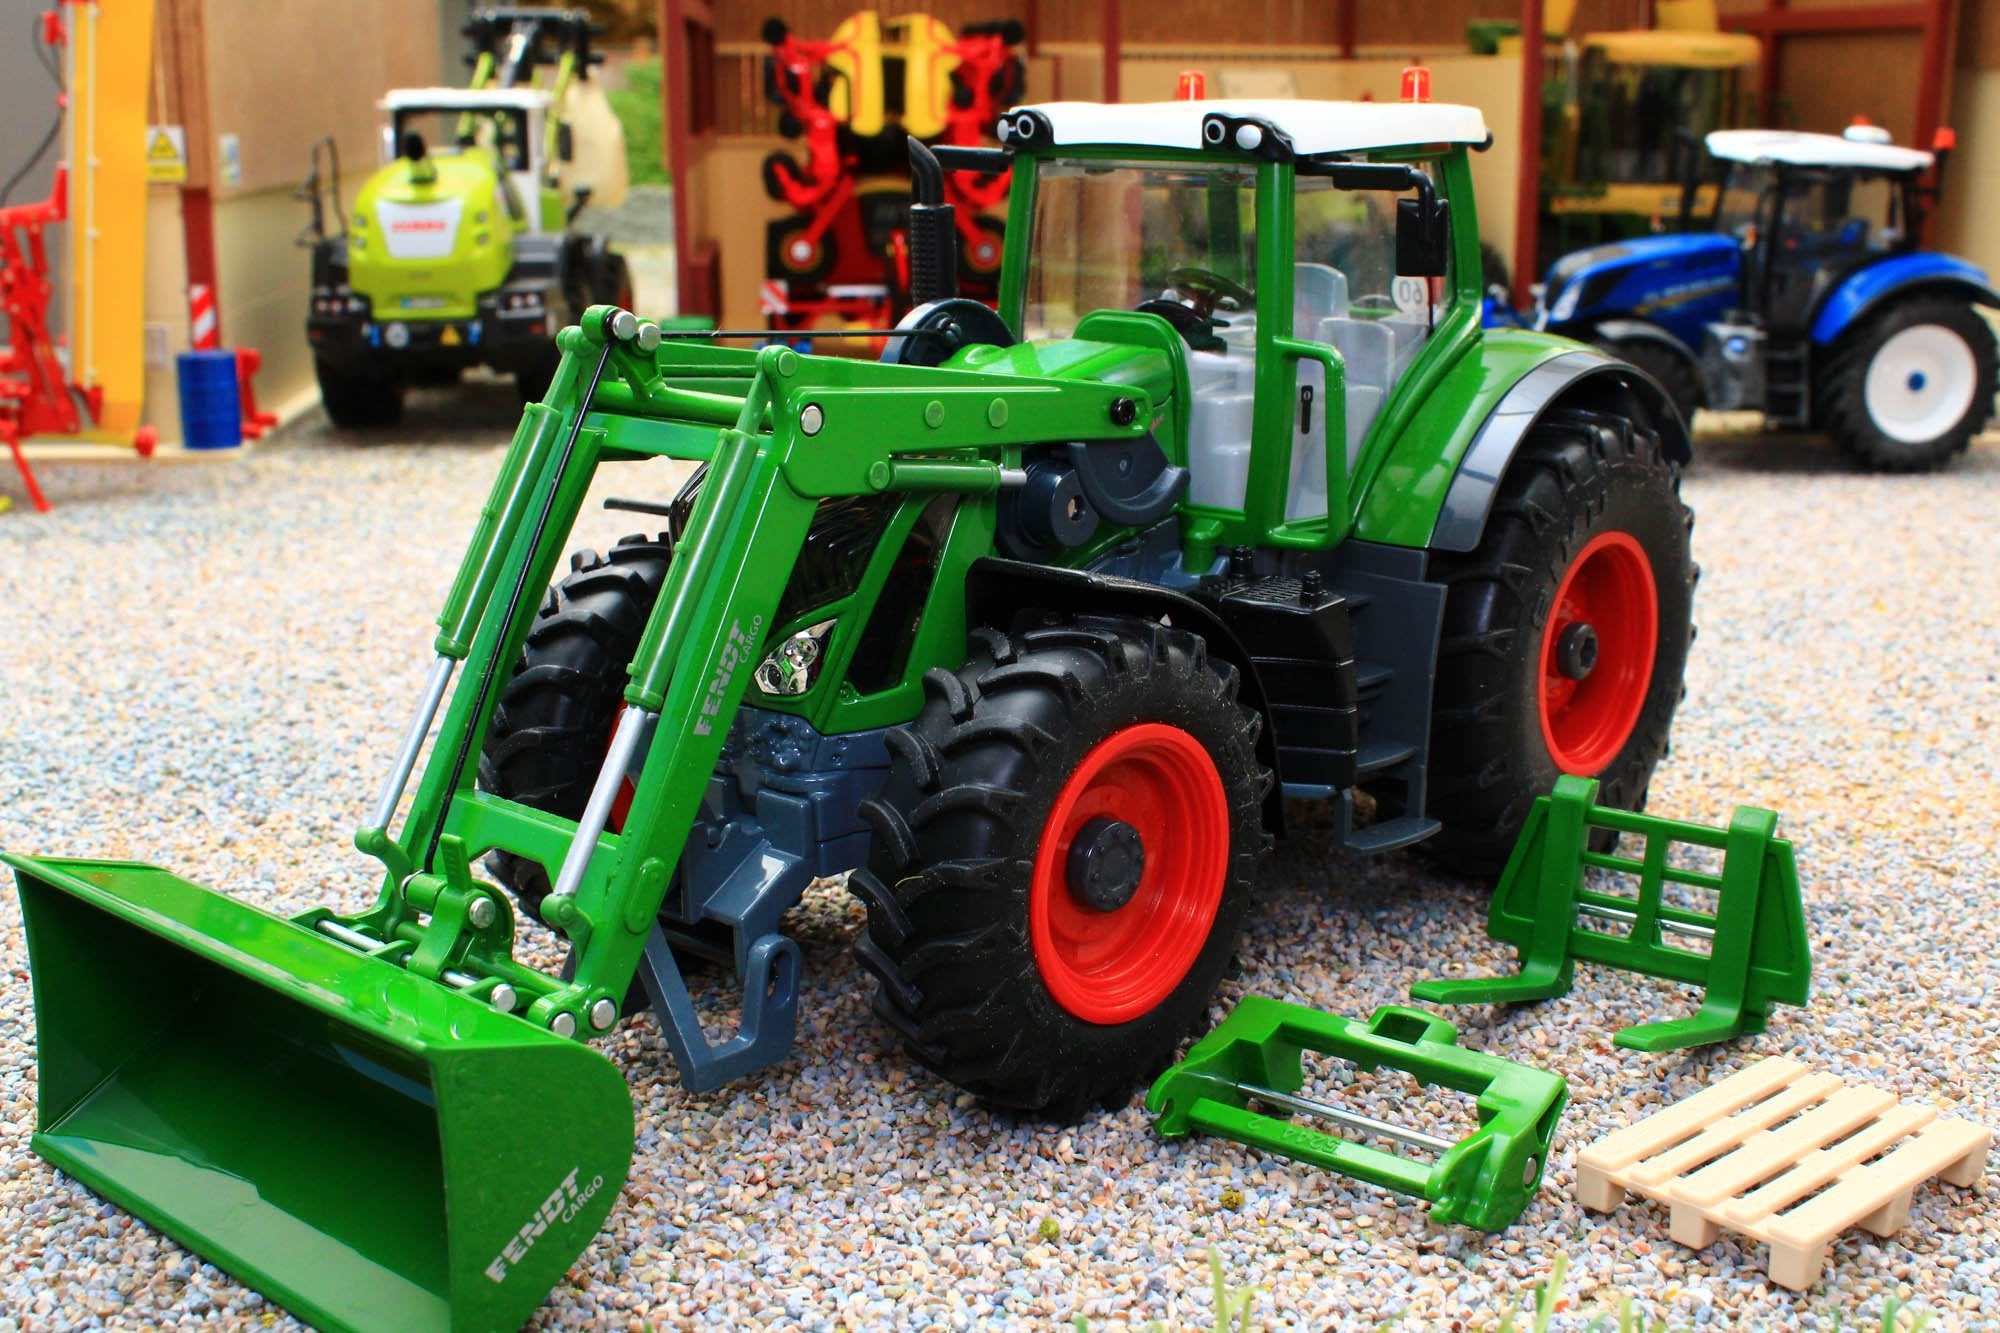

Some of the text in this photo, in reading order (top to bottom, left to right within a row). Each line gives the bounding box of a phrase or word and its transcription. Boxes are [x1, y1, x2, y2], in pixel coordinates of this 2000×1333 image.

[693, 618, 745, 736] FENDT
[739, 614, 762, 664] CARGO
[485, 1166, 579, 1284] FENDT
[562, 1175, 604, 1223] CARGO
